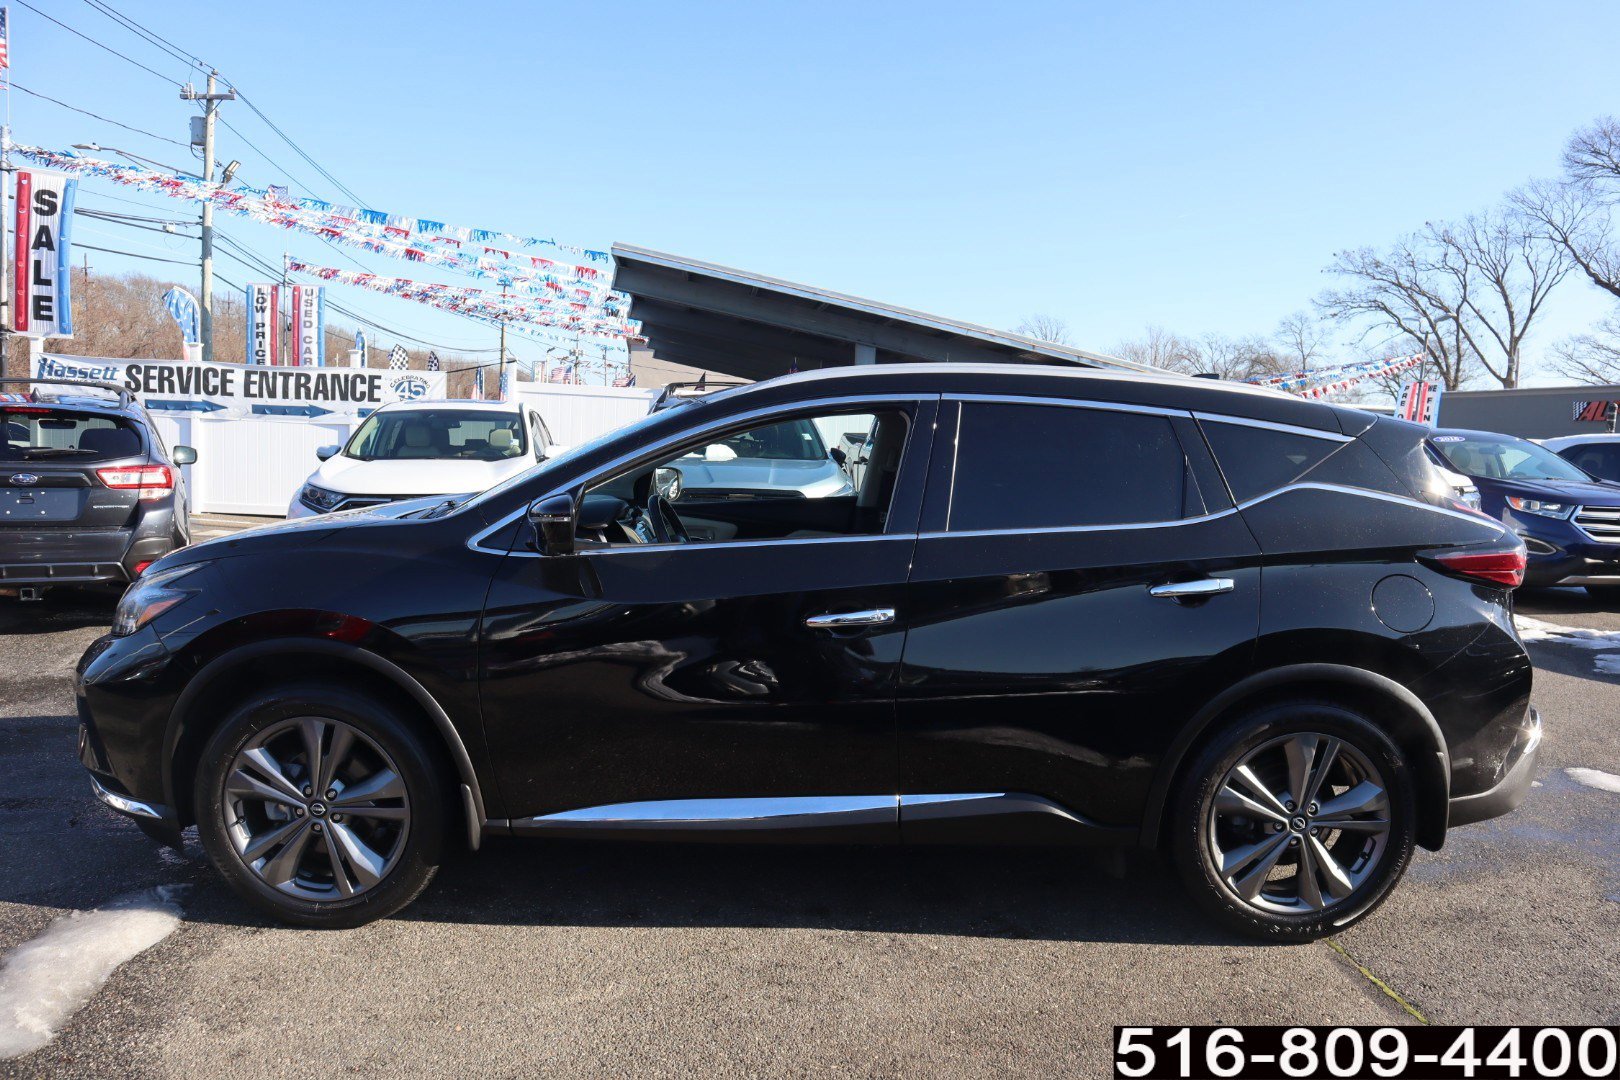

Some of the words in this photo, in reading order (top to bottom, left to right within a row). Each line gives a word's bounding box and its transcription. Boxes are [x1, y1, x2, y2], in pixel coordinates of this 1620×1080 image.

[31, 189, 58, 322] SALE
[254, 287, 267, 313] LOW
[303, 288, 314, 329] USED
[255, 322, 266, 365] PRICE
[125, 364, 235, 397] SERVICE
[243, 370, 382, 402] ENTRANCE
